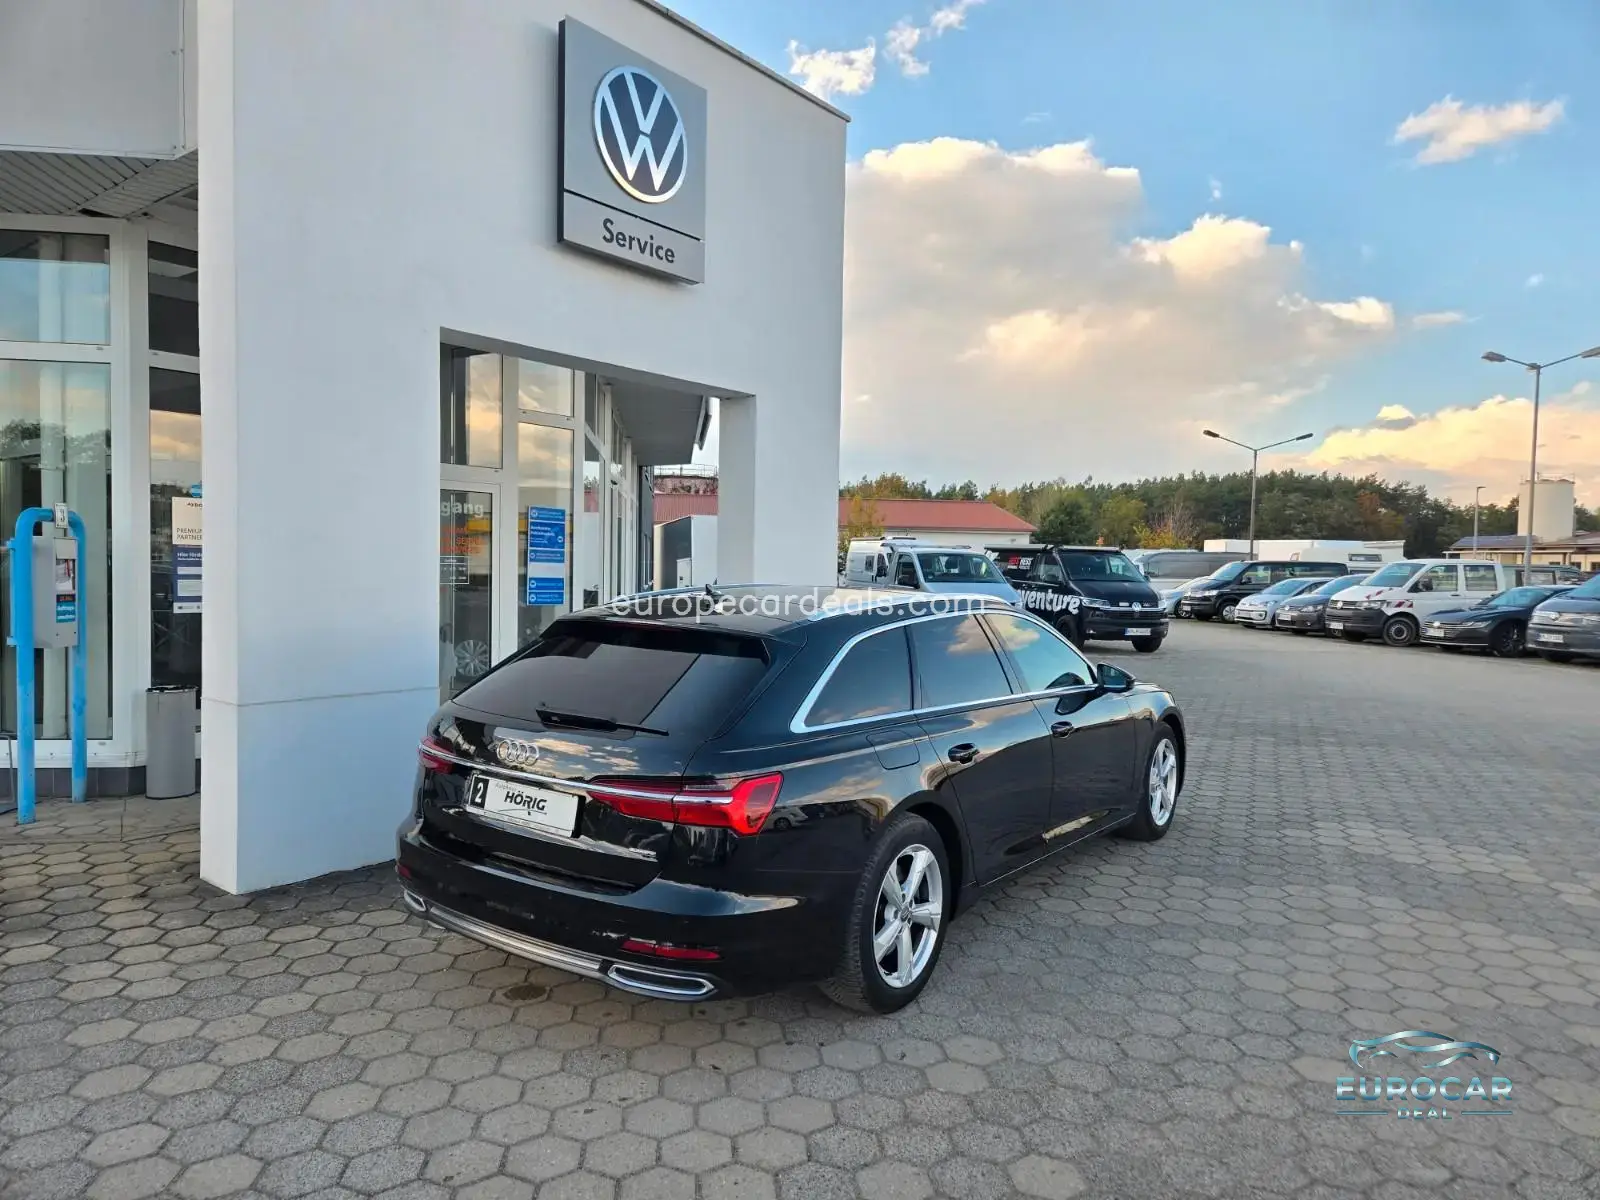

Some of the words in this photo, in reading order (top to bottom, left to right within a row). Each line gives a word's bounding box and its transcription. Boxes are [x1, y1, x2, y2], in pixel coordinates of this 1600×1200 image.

[602, 218, 676, 264] Service
[440, 501, 484, 518] gang
[1018, 589, 1081, 615] venture
[474, 782, 484, 804] 2
[504, 790, 547, 812] HÖRIG
